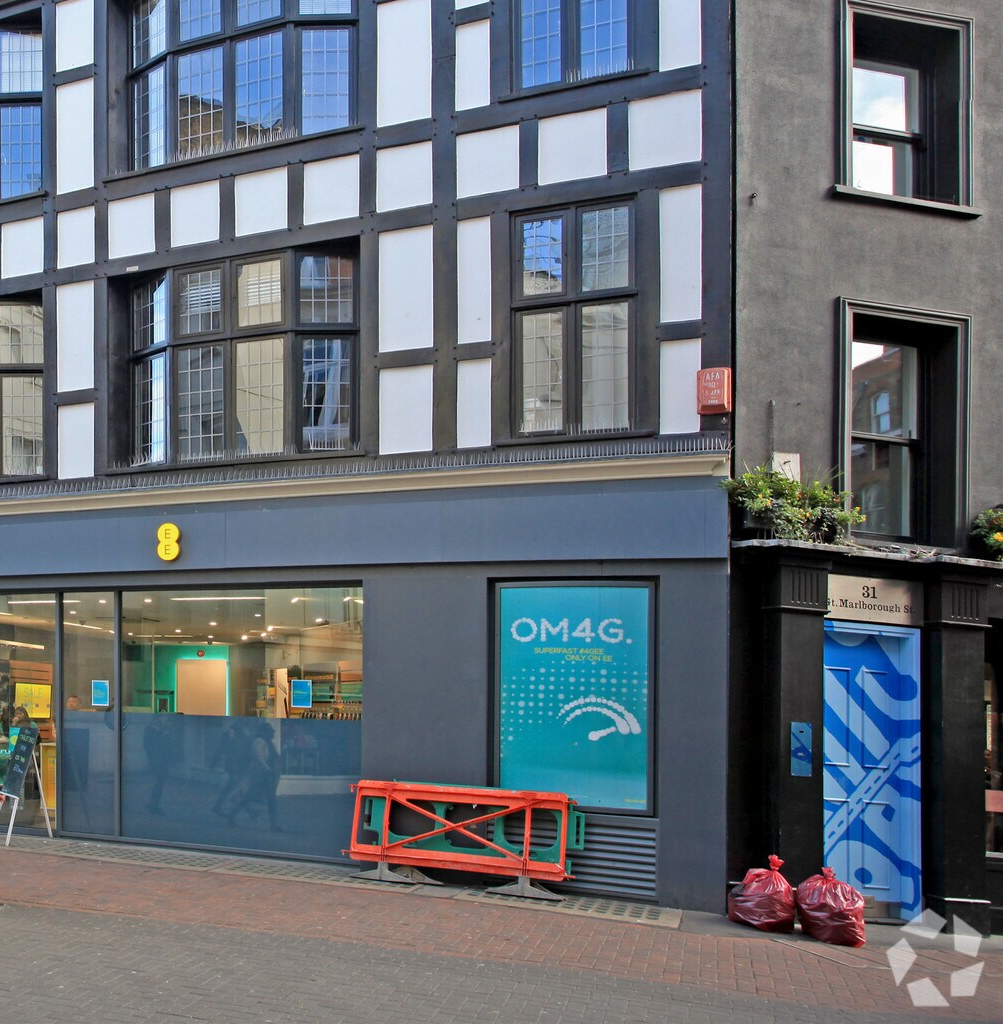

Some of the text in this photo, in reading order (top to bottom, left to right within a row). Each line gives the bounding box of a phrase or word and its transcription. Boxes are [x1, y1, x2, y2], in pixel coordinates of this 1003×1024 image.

[862, 585, 877, 599] 31
[839, 599, 901, 613] Marlborough
[510, 617, 632, 644] OM4G.
